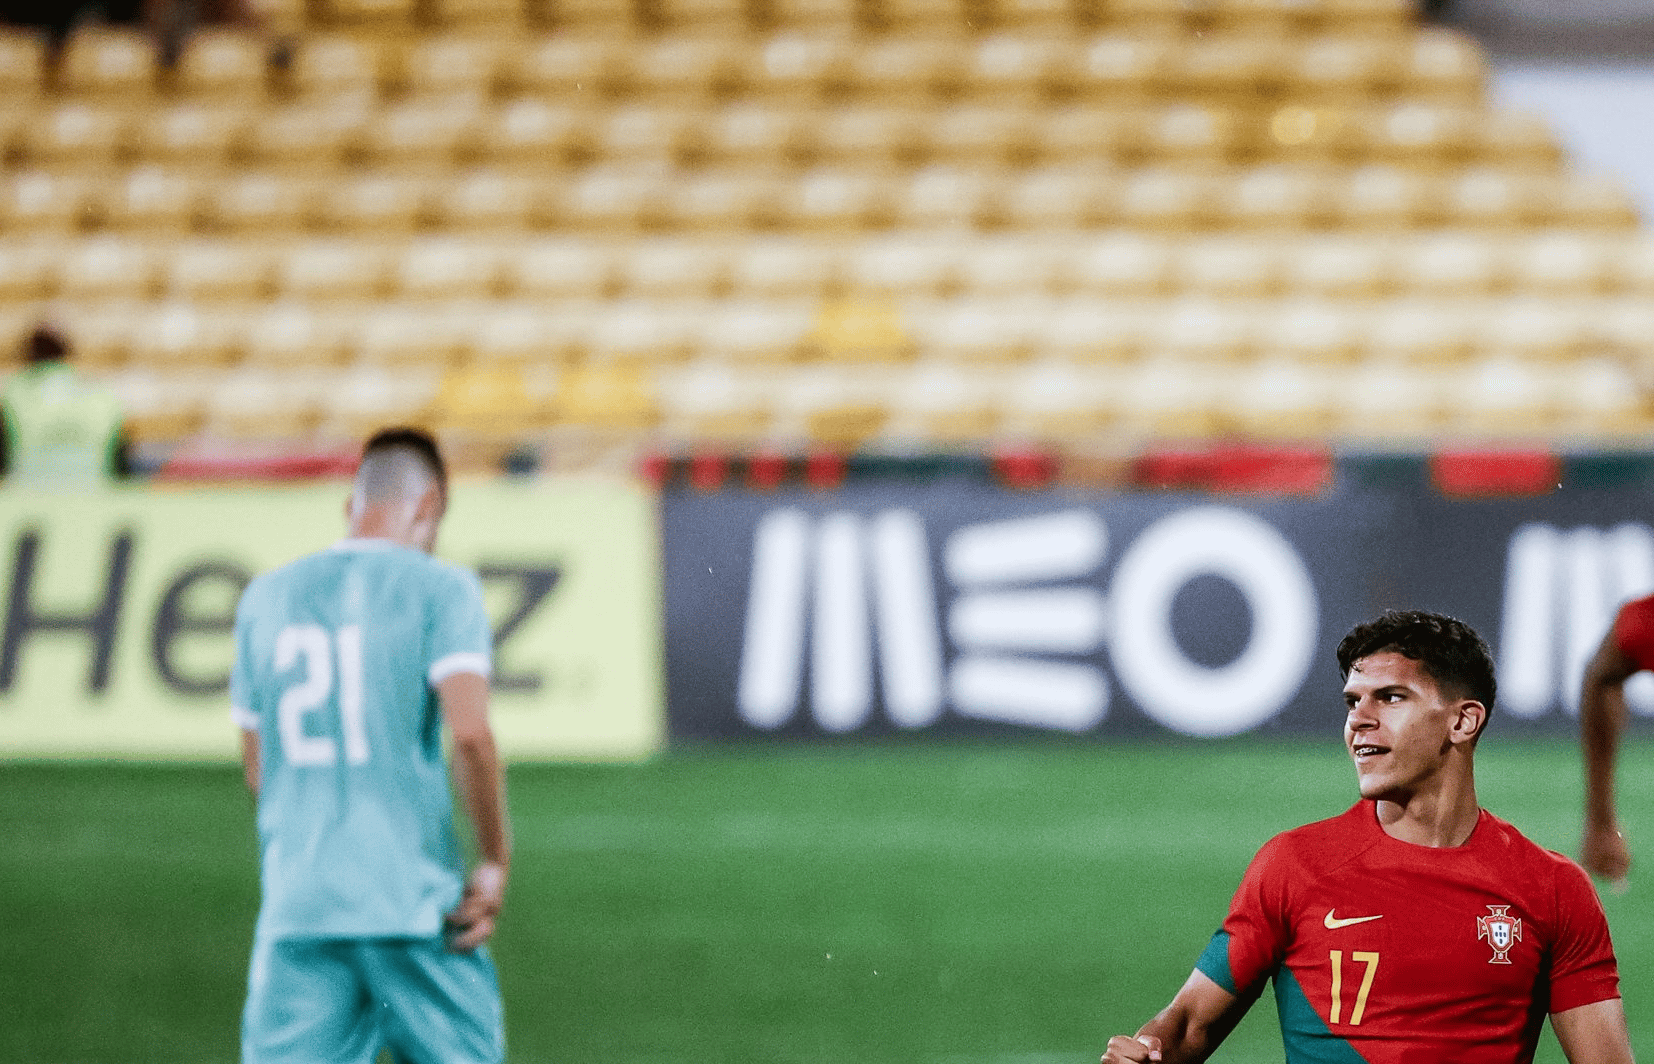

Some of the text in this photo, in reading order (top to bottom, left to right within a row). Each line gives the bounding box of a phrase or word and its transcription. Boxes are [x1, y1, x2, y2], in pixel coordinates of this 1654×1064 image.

[0, 530, 564, 697] Hez
[737, 506, 1320, 738] MEO
[273, 623, 371, 766] 21
[1329, 950, 1380, 1026] 17
